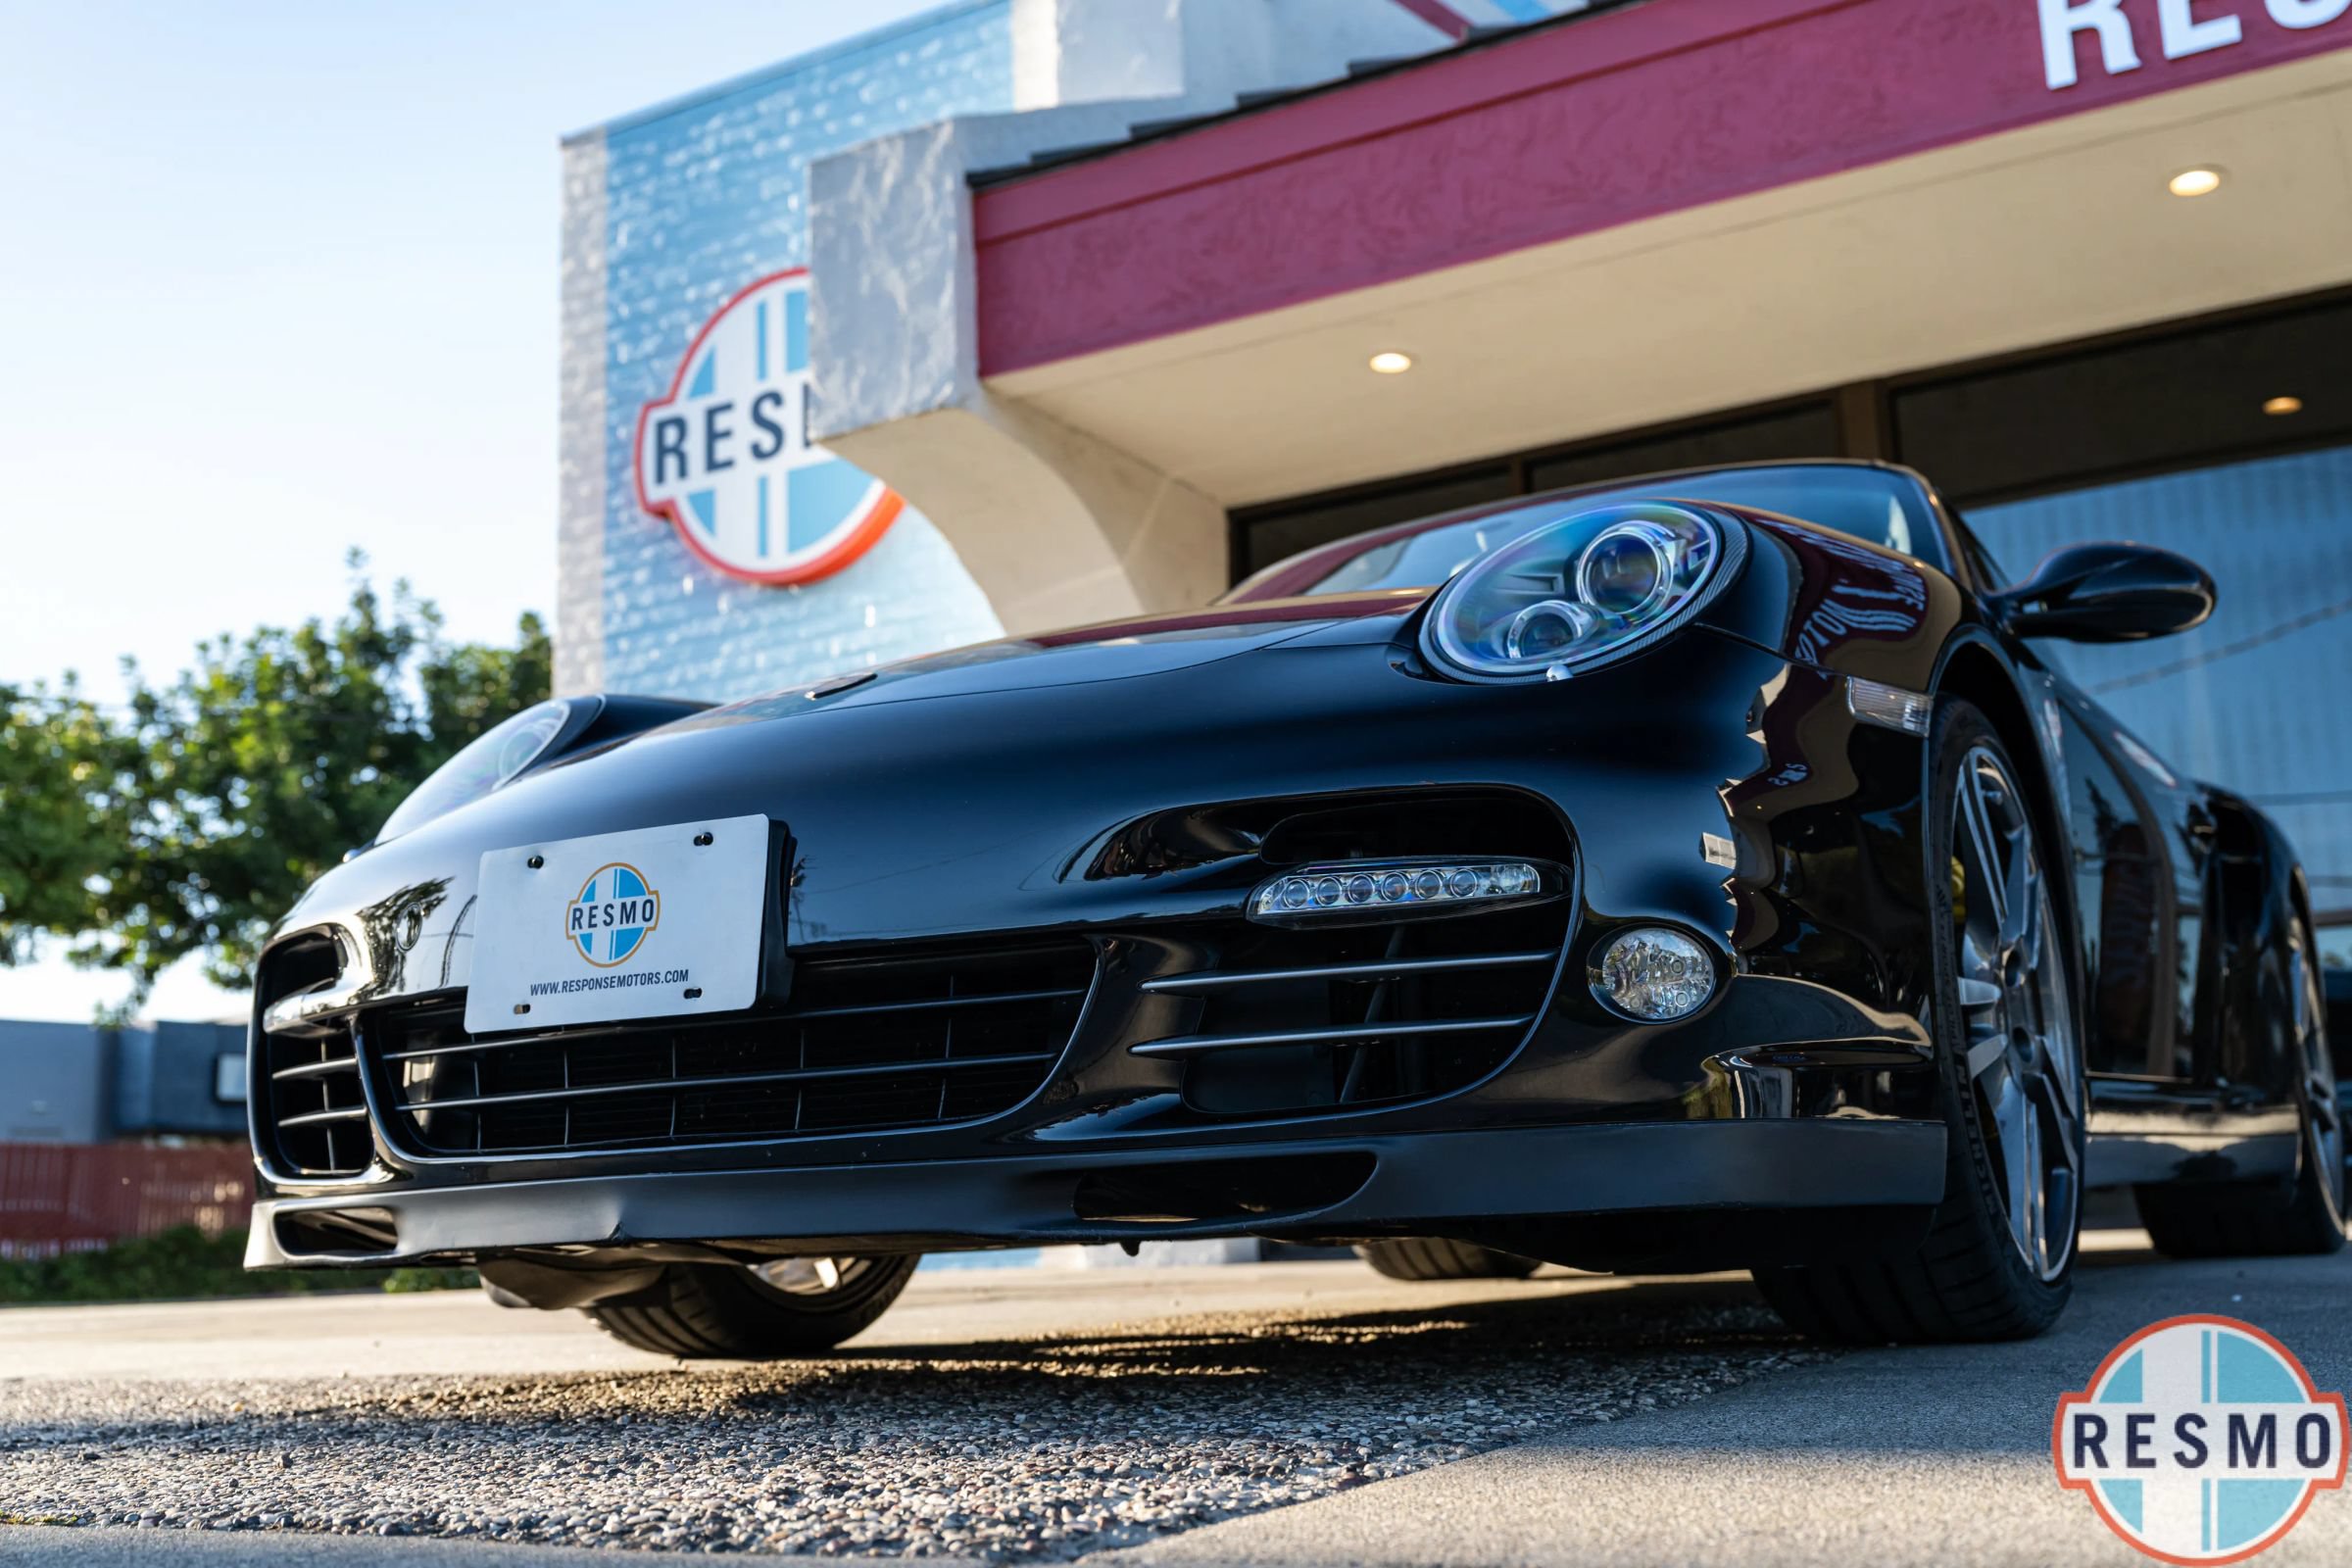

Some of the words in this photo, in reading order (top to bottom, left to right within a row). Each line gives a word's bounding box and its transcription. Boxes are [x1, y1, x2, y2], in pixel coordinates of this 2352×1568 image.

[656, 383, 811, 485] RES
[571, 899, 655, 931] RESMO
[530, 969, 689, 996] WWW.RESPONSEMOTORS.COM
